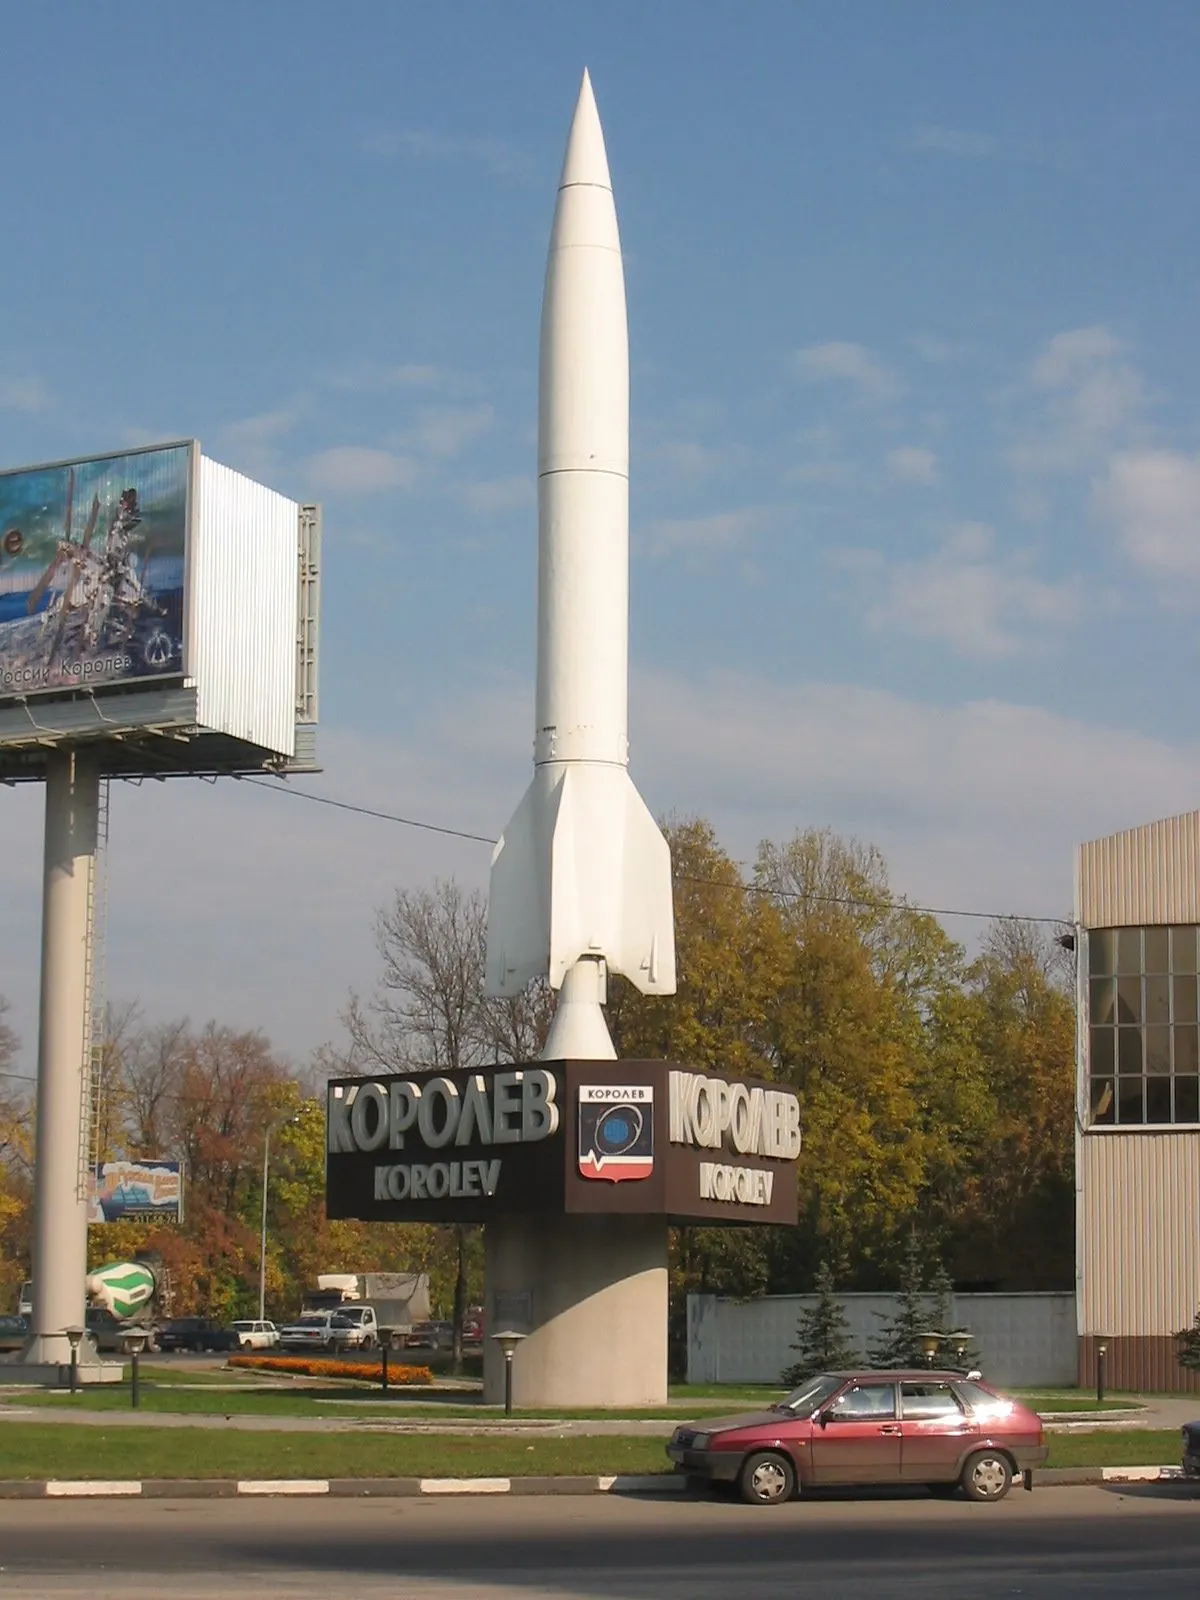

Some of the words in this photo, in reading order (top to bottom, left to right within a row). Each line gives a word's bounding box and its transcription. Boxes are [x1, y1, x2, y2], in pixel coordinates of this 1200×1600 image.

[61, 656, 132, 680] Королев
[328, 1069, 560, 1153] КОРОЛЕВ
[588, 1089, 645, 1099] КОРОЛЕВ
[668, 1070, 801, 1160] КОРОЛЕВ
[374, 1159, 502, 1201] KOROLEV
[700, 1162, 774, 1205] KOROLEV
